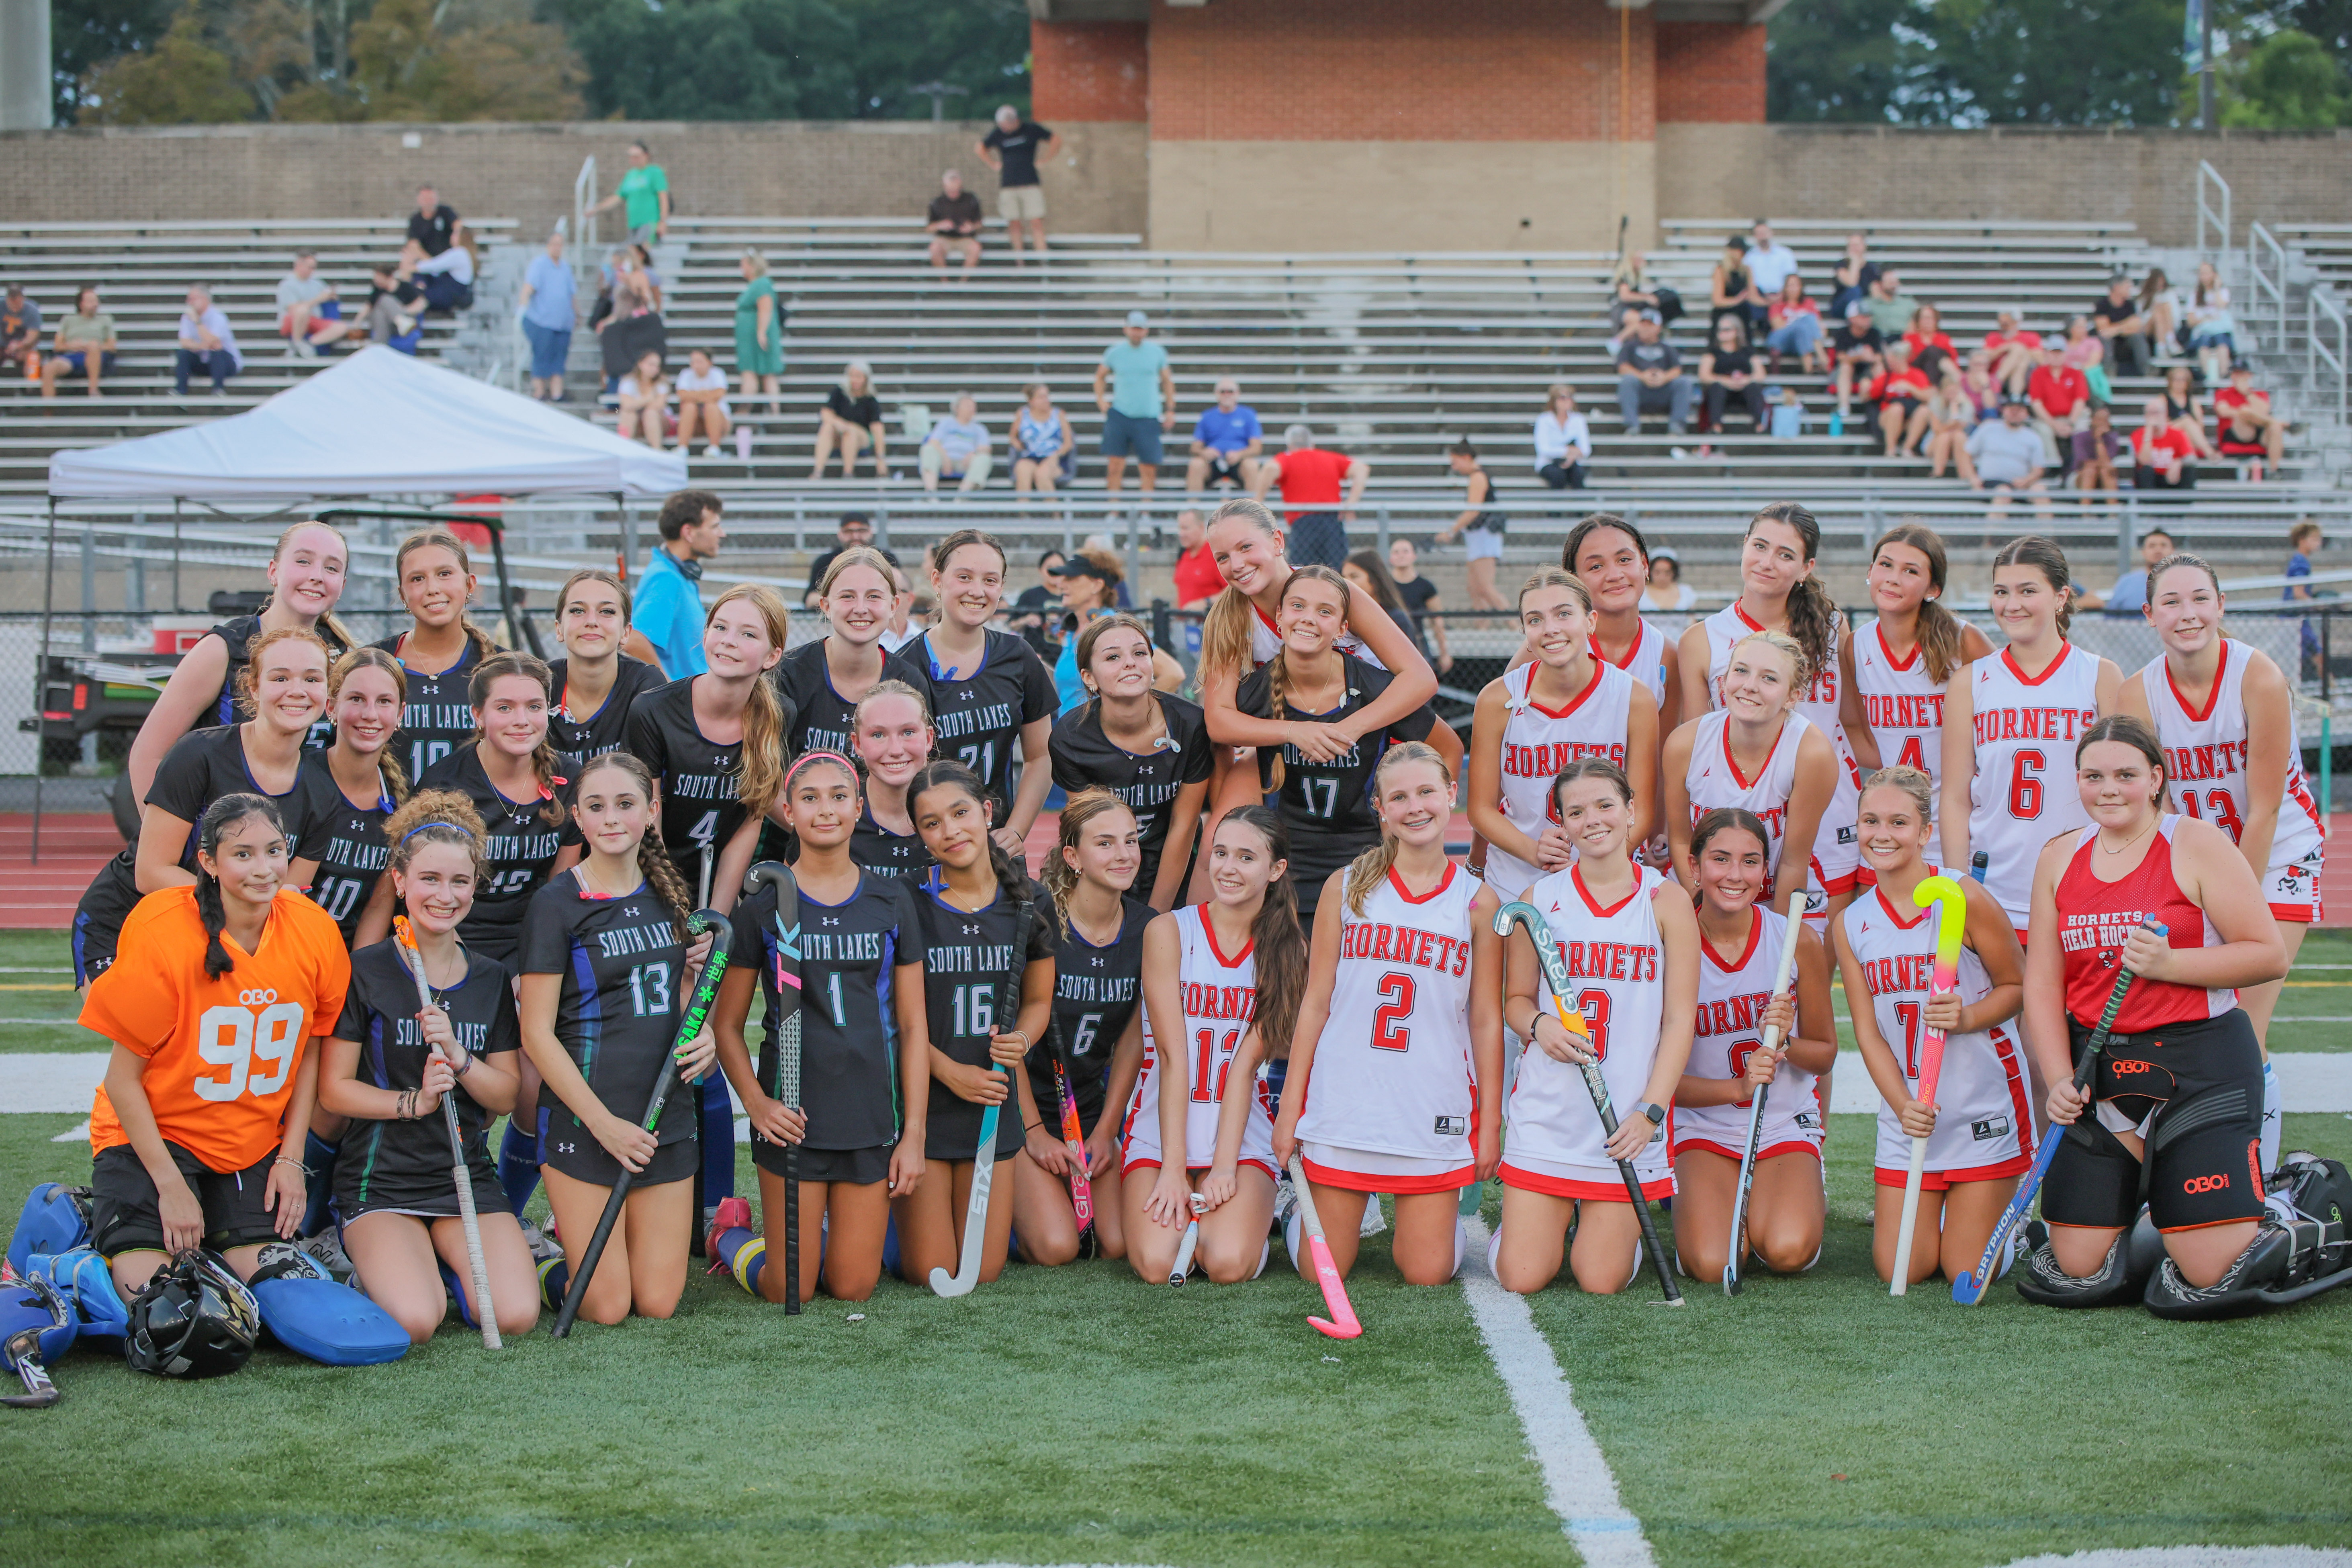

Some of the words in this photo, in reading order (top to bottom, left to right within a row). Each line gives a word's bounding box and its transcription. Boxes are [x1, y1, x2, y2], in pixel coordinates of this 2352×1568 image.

[404, 704, 430, 728] UTH
[937, 715, 974, 740] SOUTH
[976, 703, 1012, 733] LAKES
[1861, 694, 1944, 728] ORNET
[1973, 707, 2094, 747] HORNETS
[674, 773, 718, 799] SOUTH
[1149, 780, 1182, 805] LAKE
[1301, 777, 1339, 819] 17
[2008, 748, 2046, 820] 6
[687, 810, 720, 849] 4
[2181, 788, 2246, 846] 13
[326, 836, 353, 866] UTH
[353, 842, 392, 870] LAKES
[486, 835, 519, 860] OUTH
[523, 831, 560, 860] LAKES
[316, 874, 362, 921] 10
[2068, 911, 2142, 926] HORNETS
[598, 926, 646, 958] SOUTH
[800, 933, 832, 960] UTH
[837, 933, 879, 960] LAKES
[1343, 923, 1469, 978] HORNETS
[2061, 926, 2096, 953] FIELD
[706, 950, 728, 982] 世界
[928, 945, 971, 973] SOUTH
[1544, 941, 1657, 983] ORNETS
[239, 988, 278, 1006] OBO
[629, 961, 671, 1016] 13
[827, 972, 847, 1026] 1
[1056, 973, 1095, 1002] SOUTH
[1100, 977, 1135, 1003] LAKES
[951, 983, 994, 1037] 16
[1370, 971, 1416, 1053] 2
[1575, 987, 1611, 1066] 3
[194, 1002, 304, 1102] 99
[455, 1022, 487, 1051] AKES
[1072, 1013, 1104, 1057] 6
[1894, 1001, 1920, 1079] 7
[2112, 1061, 2145, 1073] OBO
[1751, 1108, 1763, 1171] GRYPHON
[971, 1161, 994, 1219] STX
[2019, 1161, 2040, 1199] SENTINEL
[2184, 1174, 2225, 1194] OBO
[1976, 1203, 2015, 1280] GRYPHON
